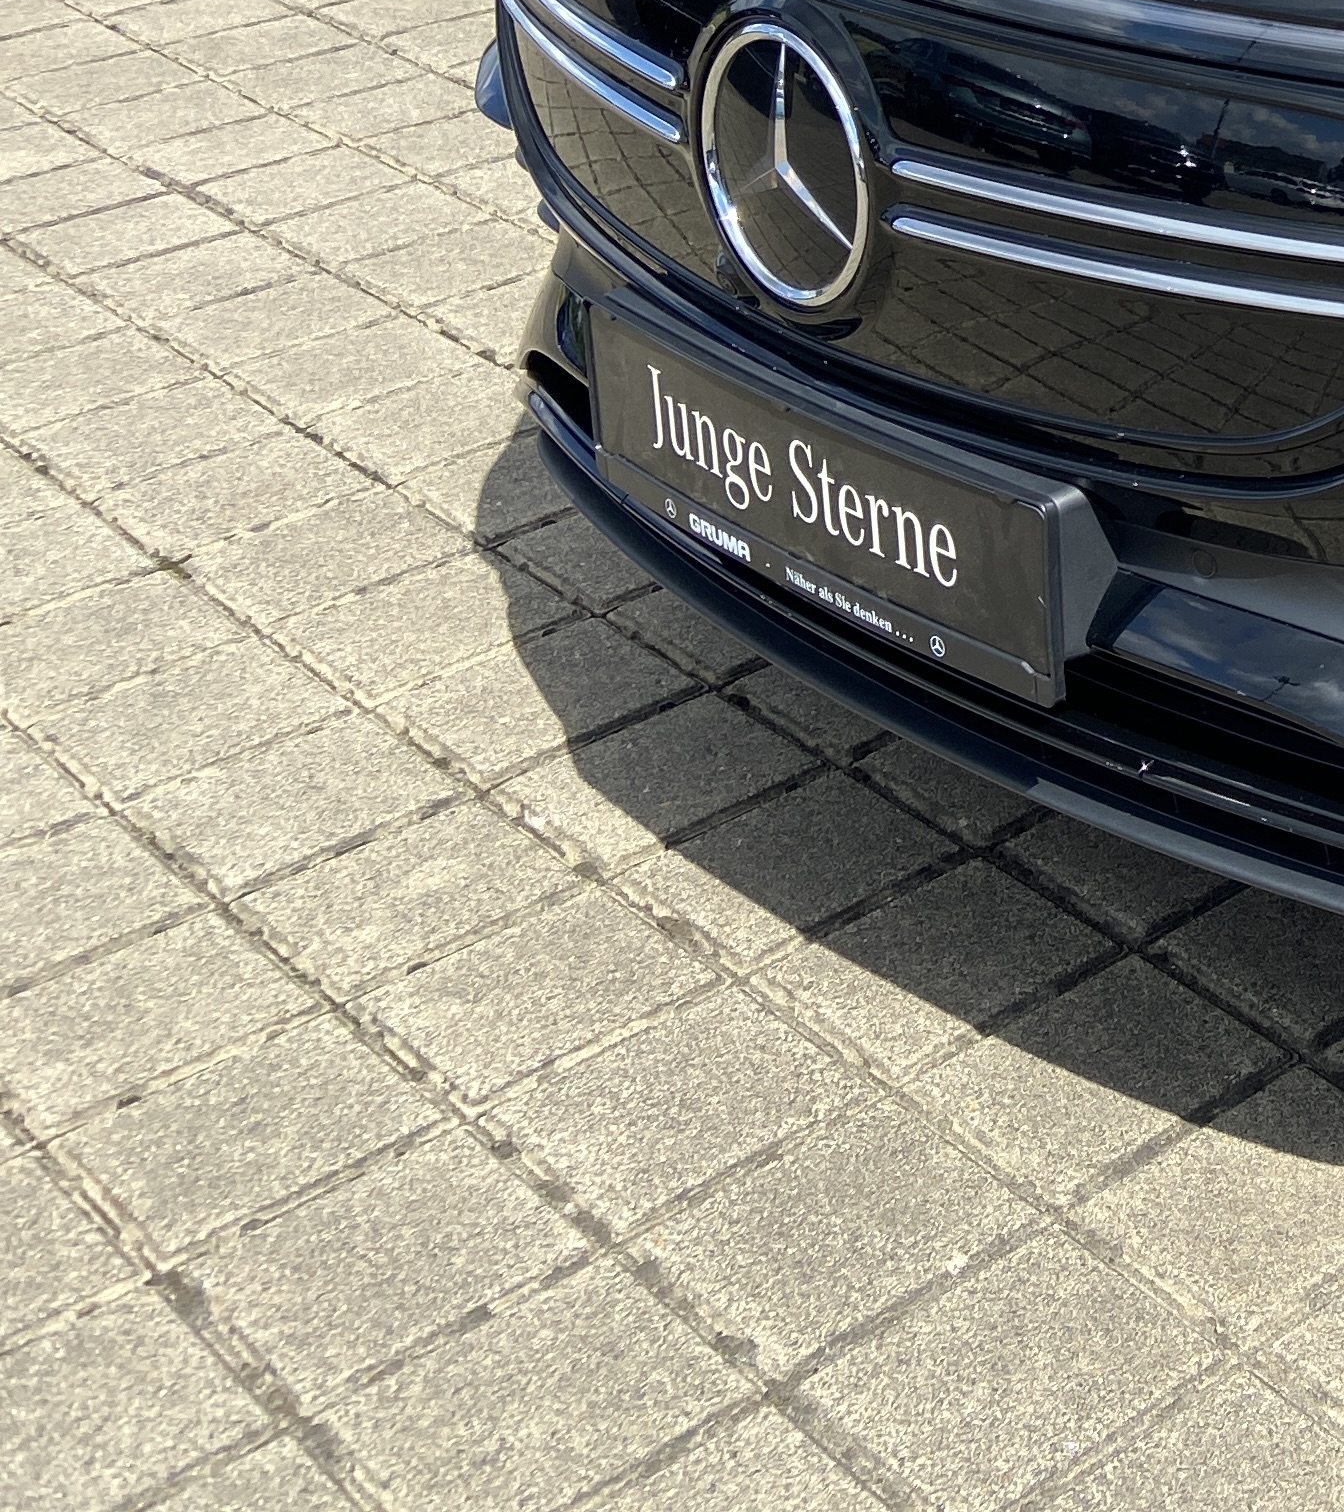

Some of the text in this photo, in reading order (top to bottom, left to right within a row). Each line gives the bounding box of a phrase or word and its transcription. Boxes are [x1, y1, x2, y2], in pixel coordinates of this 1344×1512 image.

[646, 364, 958, 588] Junge Sterne
[688, 513, 751, 562] GRUMA
[785, 566, 816, 594] Näher
[818, 587, 834, 603] als
[853, 602, 893, 633] denken
